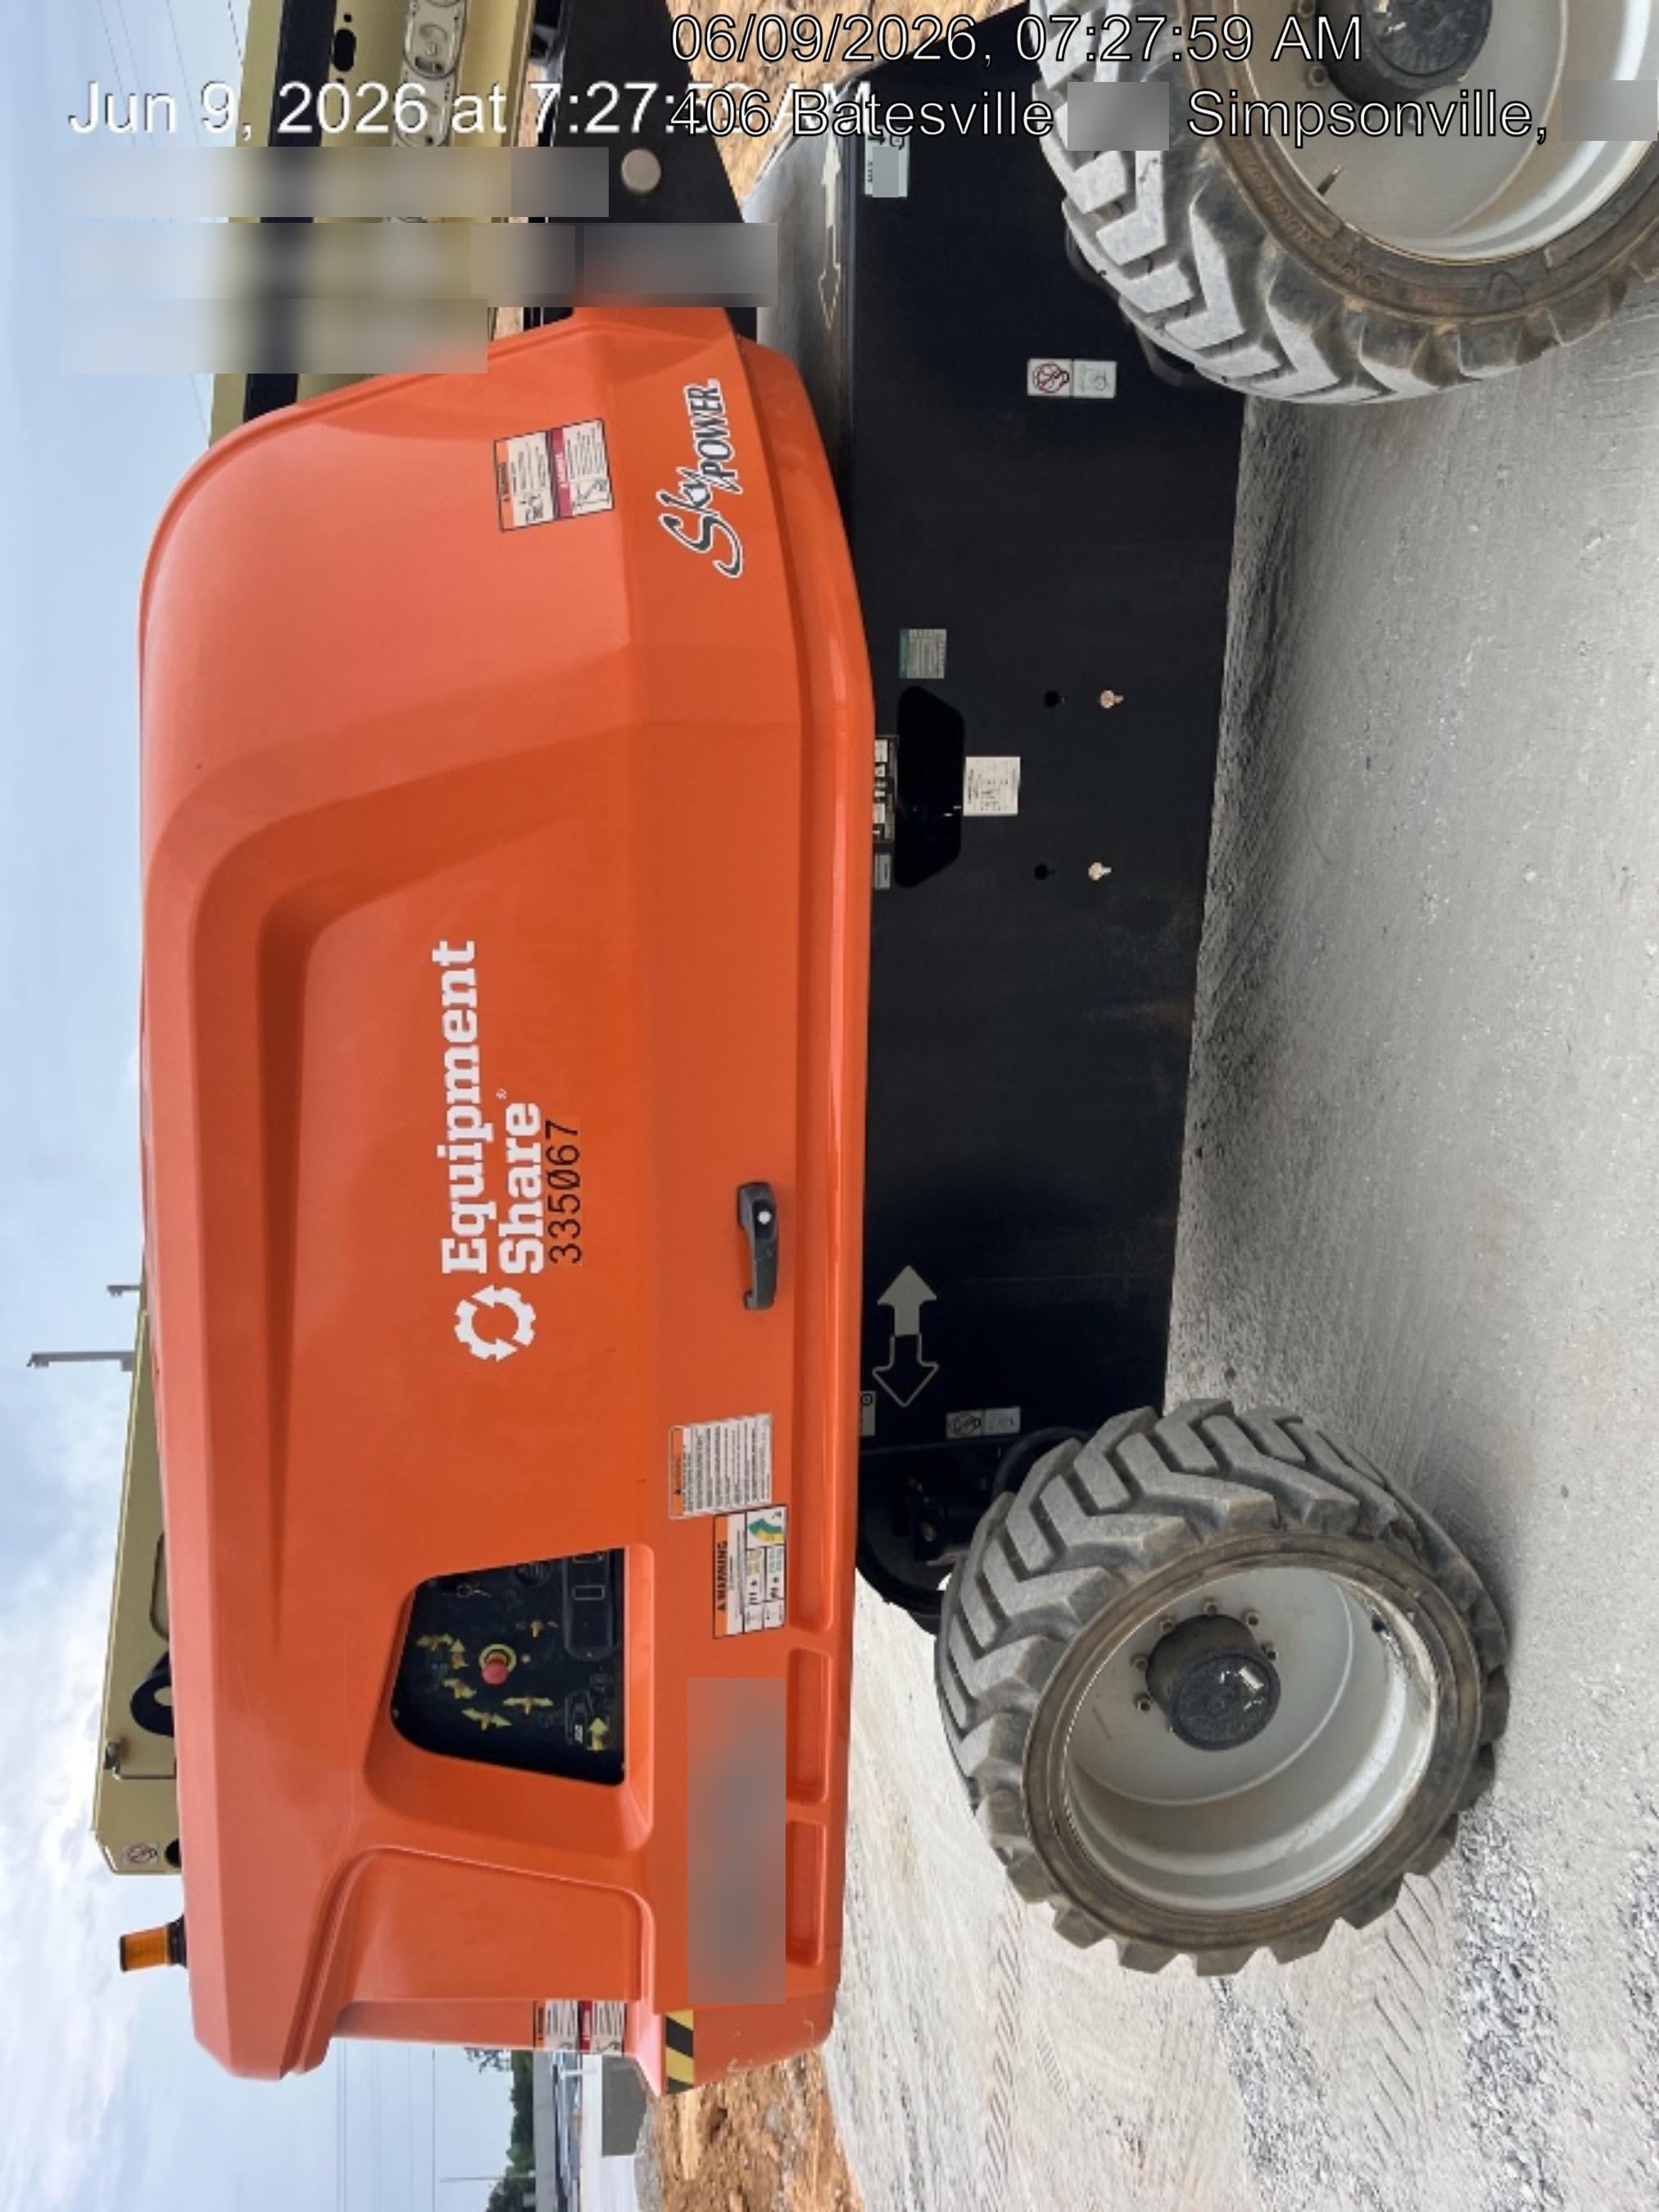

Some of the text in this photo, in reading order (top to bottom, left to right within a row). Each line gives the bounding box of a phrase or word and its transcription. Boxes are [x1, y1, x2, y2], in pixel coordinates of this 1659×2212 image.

[655, 378, 742, 577] Sky POWER
[432, 941, 496, 1274] Equipment
[498, 1103, 544, 1274] Share
[545, 1119, 582, 1265] 335067
[717, 1540, 728, 1601] WARNING
